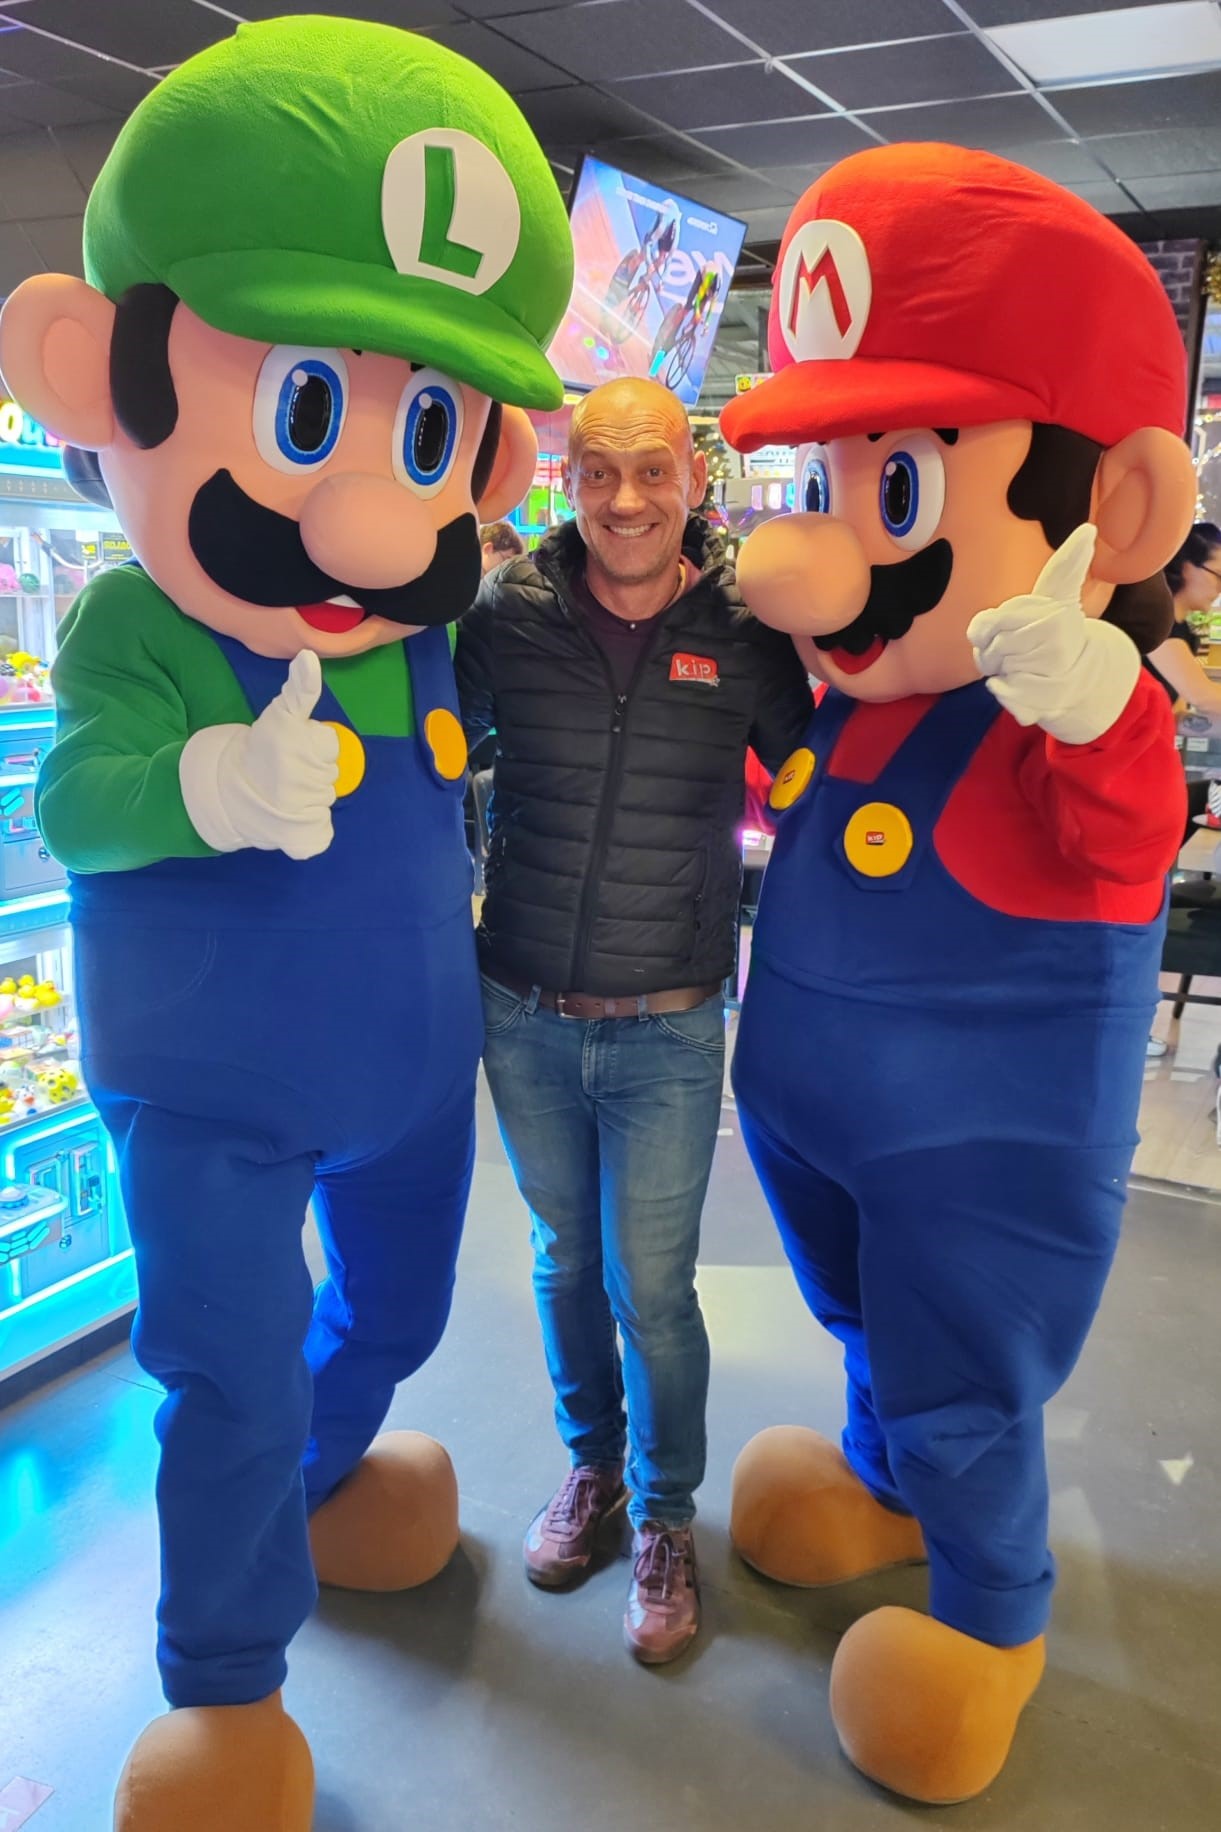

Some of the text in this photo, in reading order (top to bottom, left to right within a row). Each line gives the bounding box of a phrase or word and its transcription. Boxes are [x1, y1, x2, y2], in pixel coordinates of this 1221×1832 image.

[418, 145, 483, 278] L
[787, 243, 852, 339] M
[676, 659, 711, 678] kip
